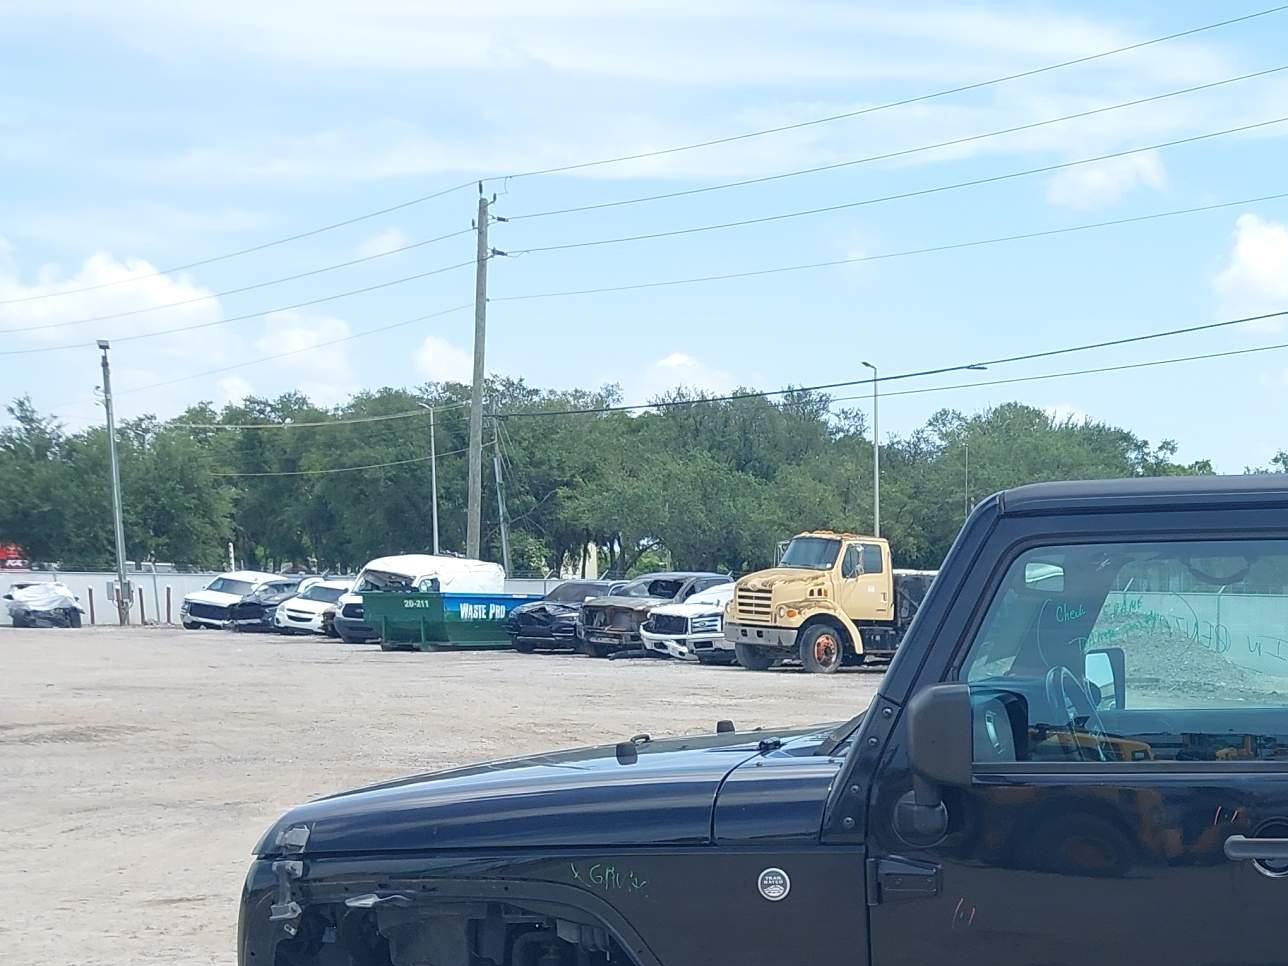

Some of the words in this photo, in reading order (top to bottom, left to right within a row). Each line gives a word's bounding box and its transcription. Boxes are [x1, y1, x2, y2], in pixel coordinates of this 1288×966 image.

[403, 599, 429, 608] 20-211
[459, 603, 487, 620] WASTE
[489, 603, 506, 619] PRO
